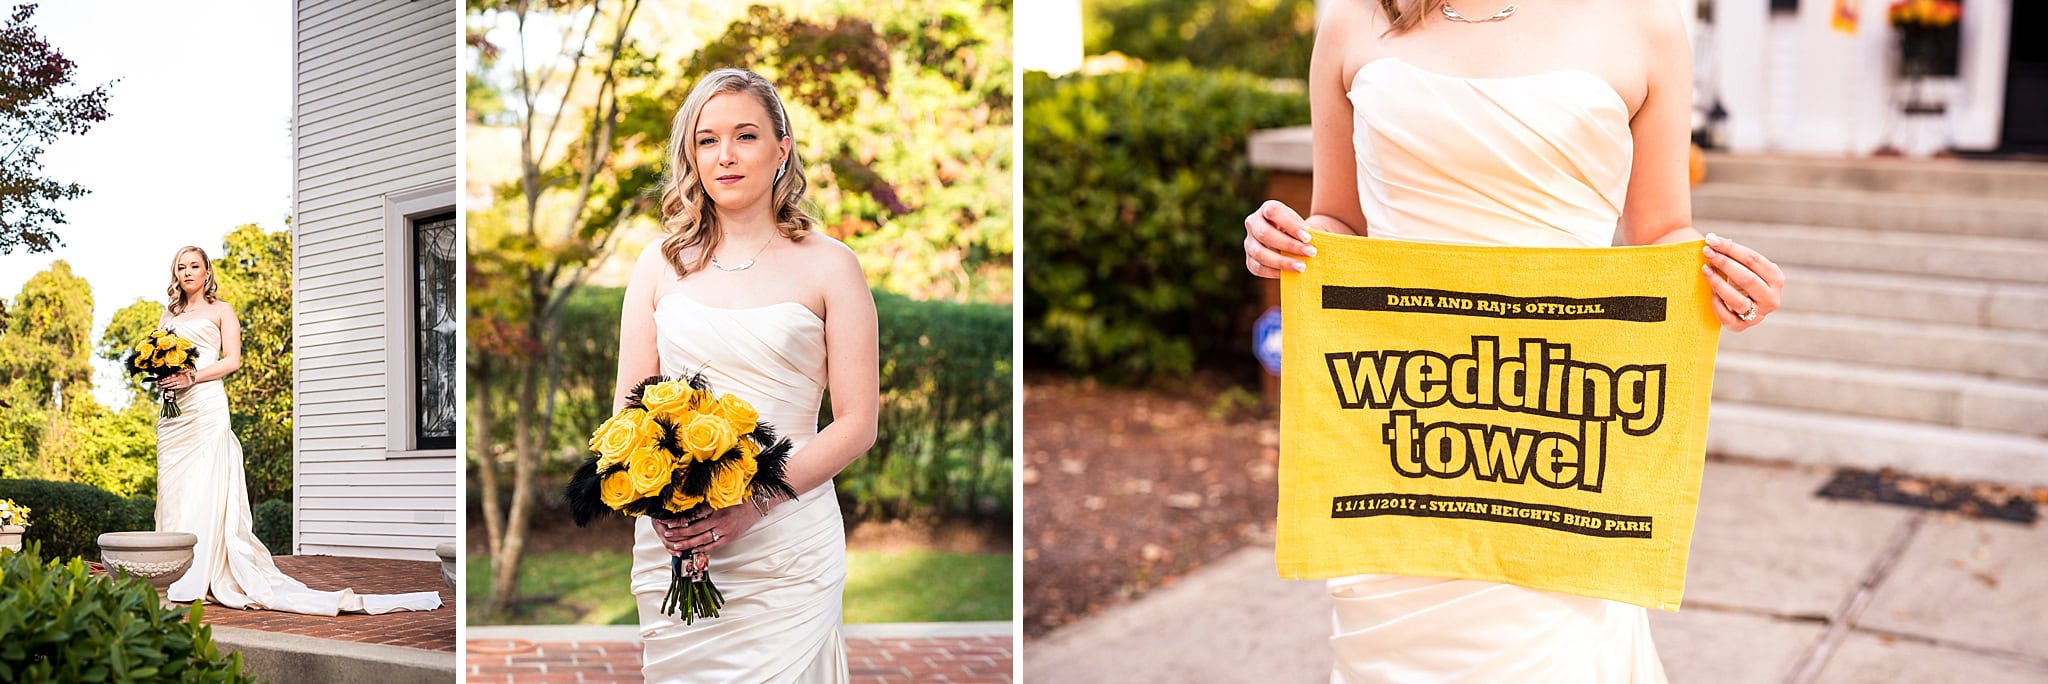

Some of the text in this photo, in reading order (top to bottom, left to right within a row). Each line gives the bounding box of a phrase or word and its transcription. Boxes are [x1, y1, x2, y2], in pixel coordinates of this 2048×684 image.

[1387, 294, 1605, 315] DANA AND RAJ'S OFFICIAL
[1325, 335, 1667, 436] wedding
[1383, 410, 1606, 493] towel
[1335, 498, 1416, 512] 11/11/2017
[1429, 501, 1488, 514] SYLVAN
[1491, 504, 1561, 522] HEIGHTS
[1563, 513, 1602, 529] BIRD
[1604, 519, 1651, 531] PARK
